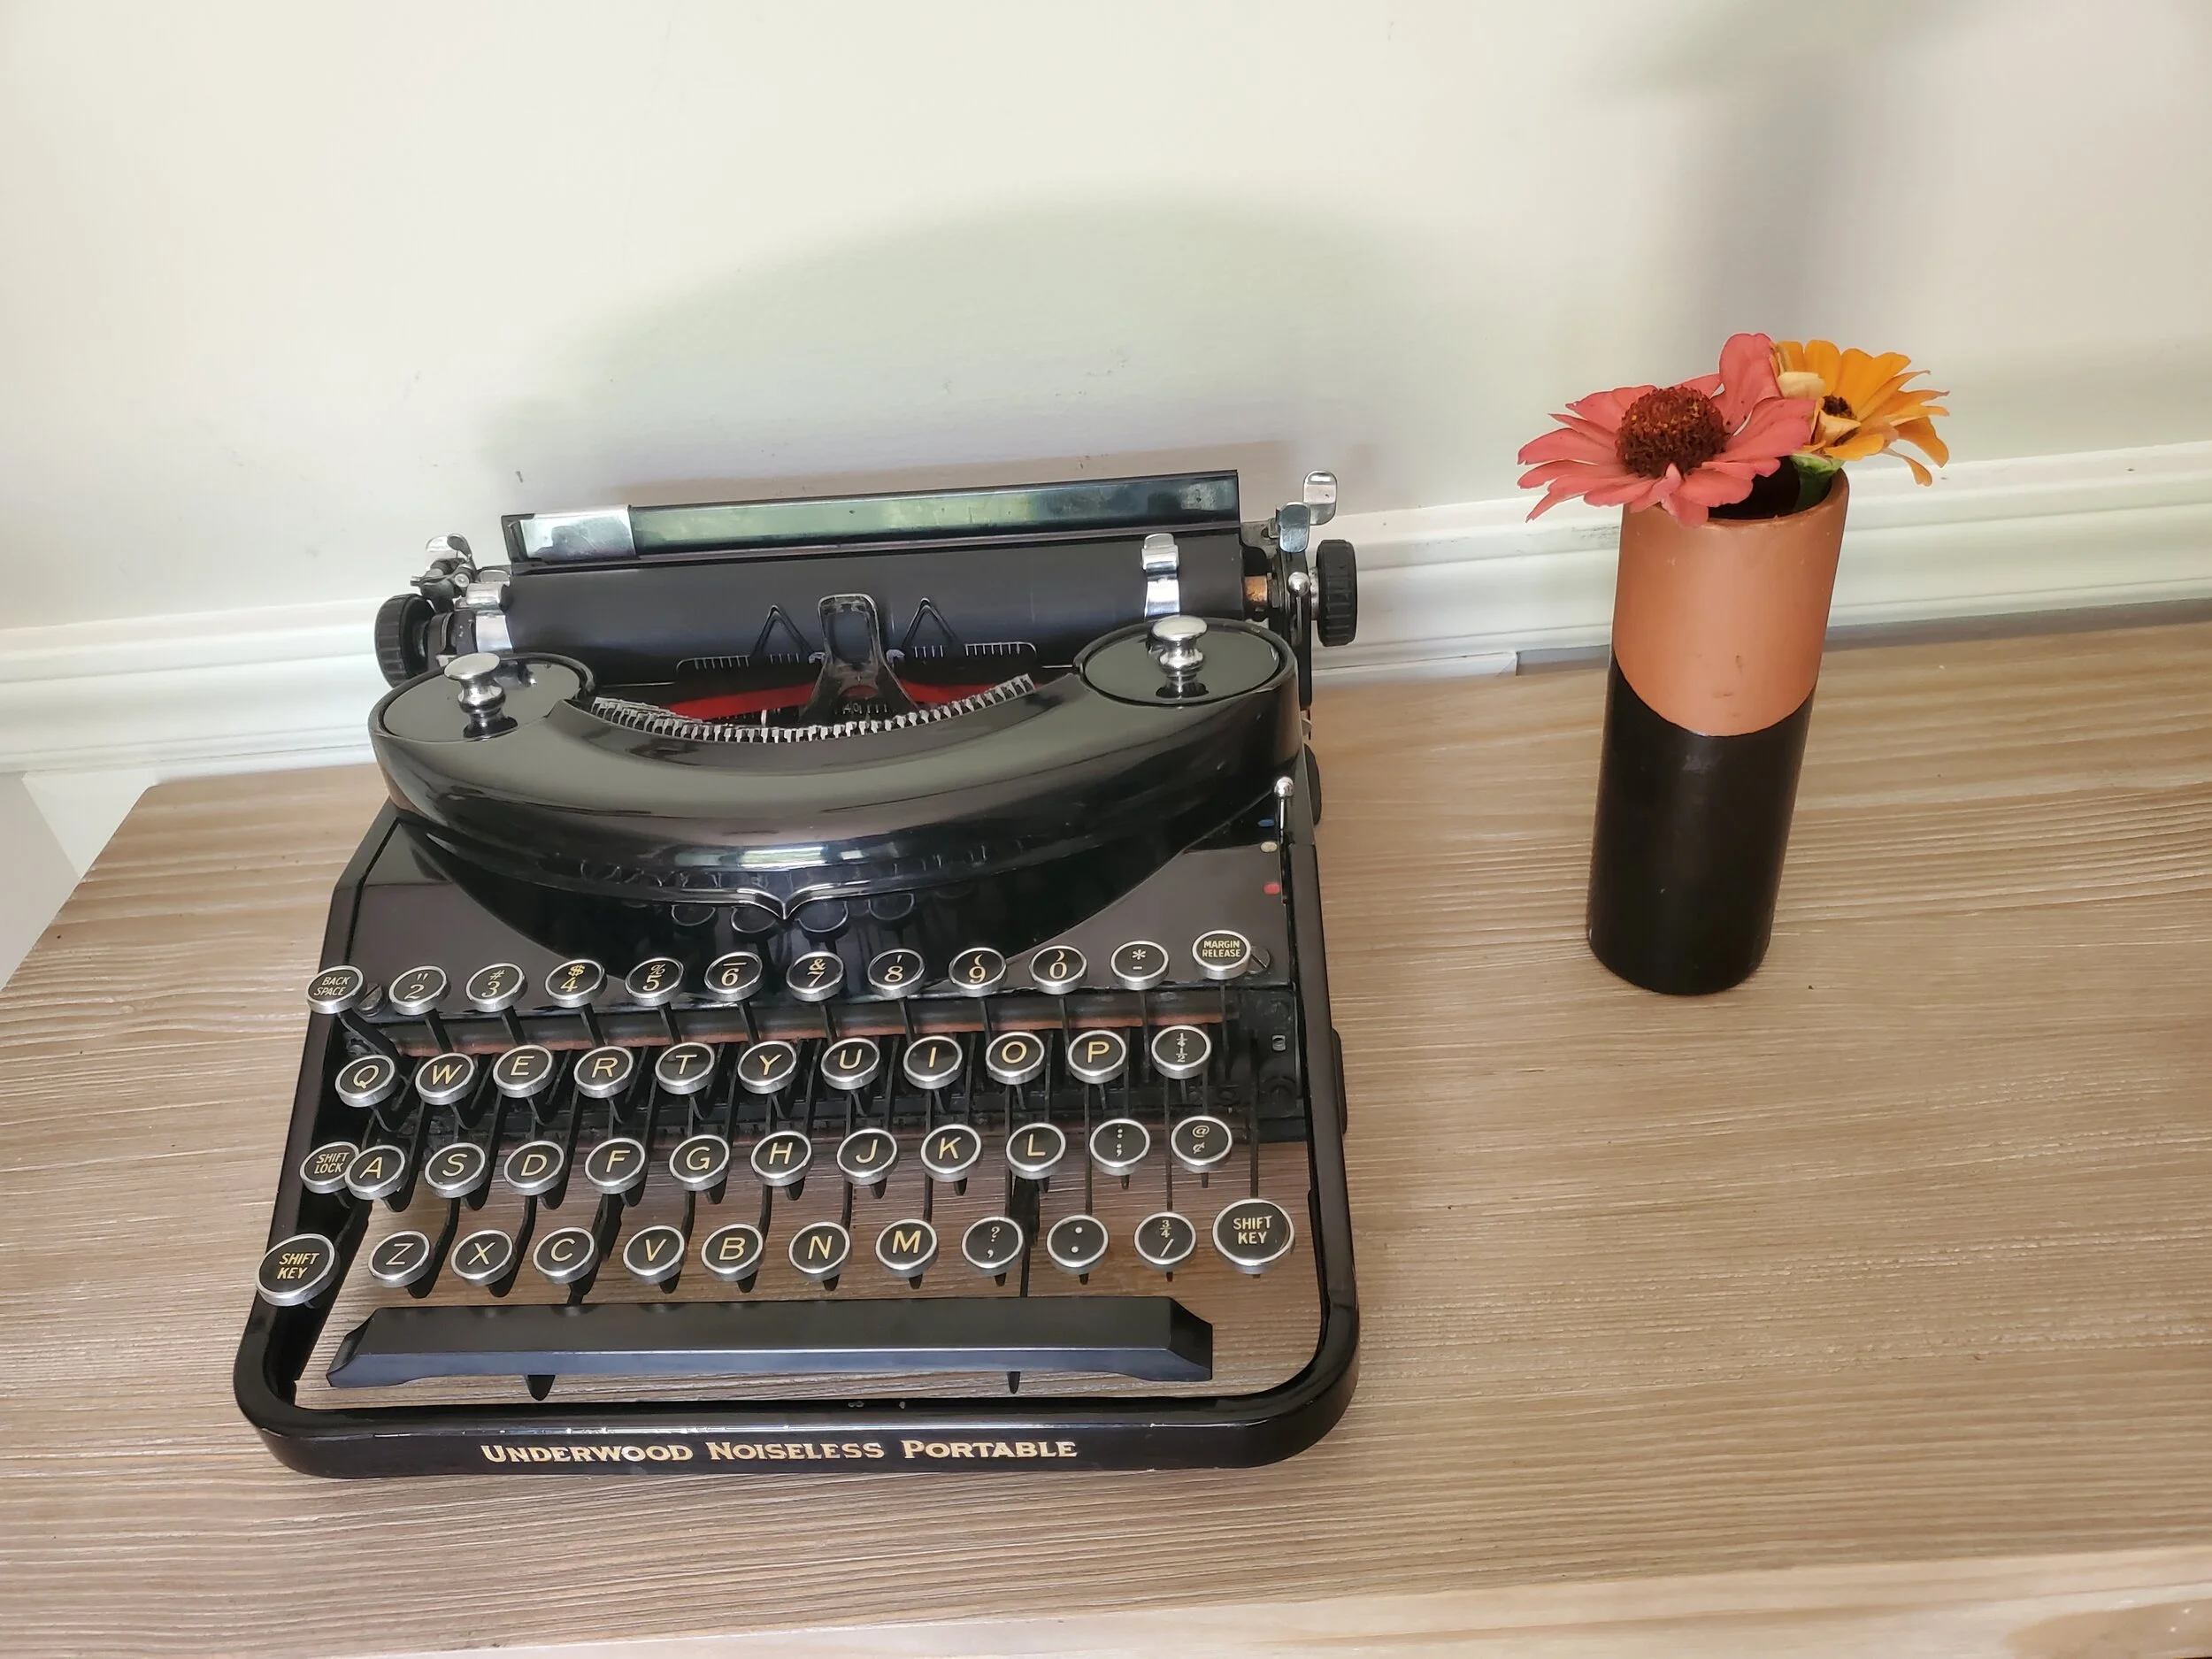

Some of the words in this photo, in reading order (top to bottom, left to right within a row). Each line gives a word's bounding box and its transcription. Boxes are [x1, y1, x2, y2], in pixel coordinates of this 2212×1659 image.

[1202, 949, 1241, 958] RELEASE
[1203, 940, 1240, 949] MARGIN
[321, 976, 351, 987] BACK
[560, 976, 579, 992] 4
[642, 974, 663, 991] 5
[721, 968, 740, 987] 6
[806, 971, 826, 988] 7
[884, 965, 903, 982] 8
[968, 966, 987, 984] 9
[313, 986, 345, 996] SPACE
[404, 984, 426, 1000] 2
[481, 980, 501, 998] 3
[839, 1048, 863, 1070] U
[928, 1047, 937, 1068] I
[1002, 1041, 1027, 1064] O
[1087, 1041, 1110, 1064] P
[431, 1064, 464, 1086] W
[510, 1056, 535, 1077] E
[590, 1057, 618, 1079] R
[675, 1054, 698, 1075] T
[758, 1054, 782, 1075] Y
[352, 1064, 380, 1089] Q
[768, 1141, 794, 1165] H
[855, 1139, 879, 1164] J
[938, 1136, 962, 1160] K
[1027, 1133, 1047, 1156] L
[314, 1162, 343, 1174] LOCK
[316, 1152, 349, 1164] SHIFT
[358, 1156, 383, 1179] A
[442, 1153, 468, 1178] S
[520, 1154, 547, 1177] D
[605, 1149, 631, 1173] F
[685, 1147, 711, 1171] G
[1233, 1216, 1272, 1231] SHIFT
[718, 1237, 746, 1261] B
[807, 1235, 833, 1260] N
[891, 1230, 922, 1254] M
[1238, 1231, 1267, 1245] KEY
[278, 1252, 320, 1265] SHIFT
[385, 1242, 415, 1266] Z
[466, 1242, 496, 1265] X
[549, 1238, 576, 1262] C
[644, 1239, 667, 1262] V
[276, 1266, 308, 1280] KEY
[480, 1444, 694, 1463] UNDERWOOD
[705, 1441, 885, 1461] NOISELESS
[901, 1440, 1078, 1460] PORTABLE
